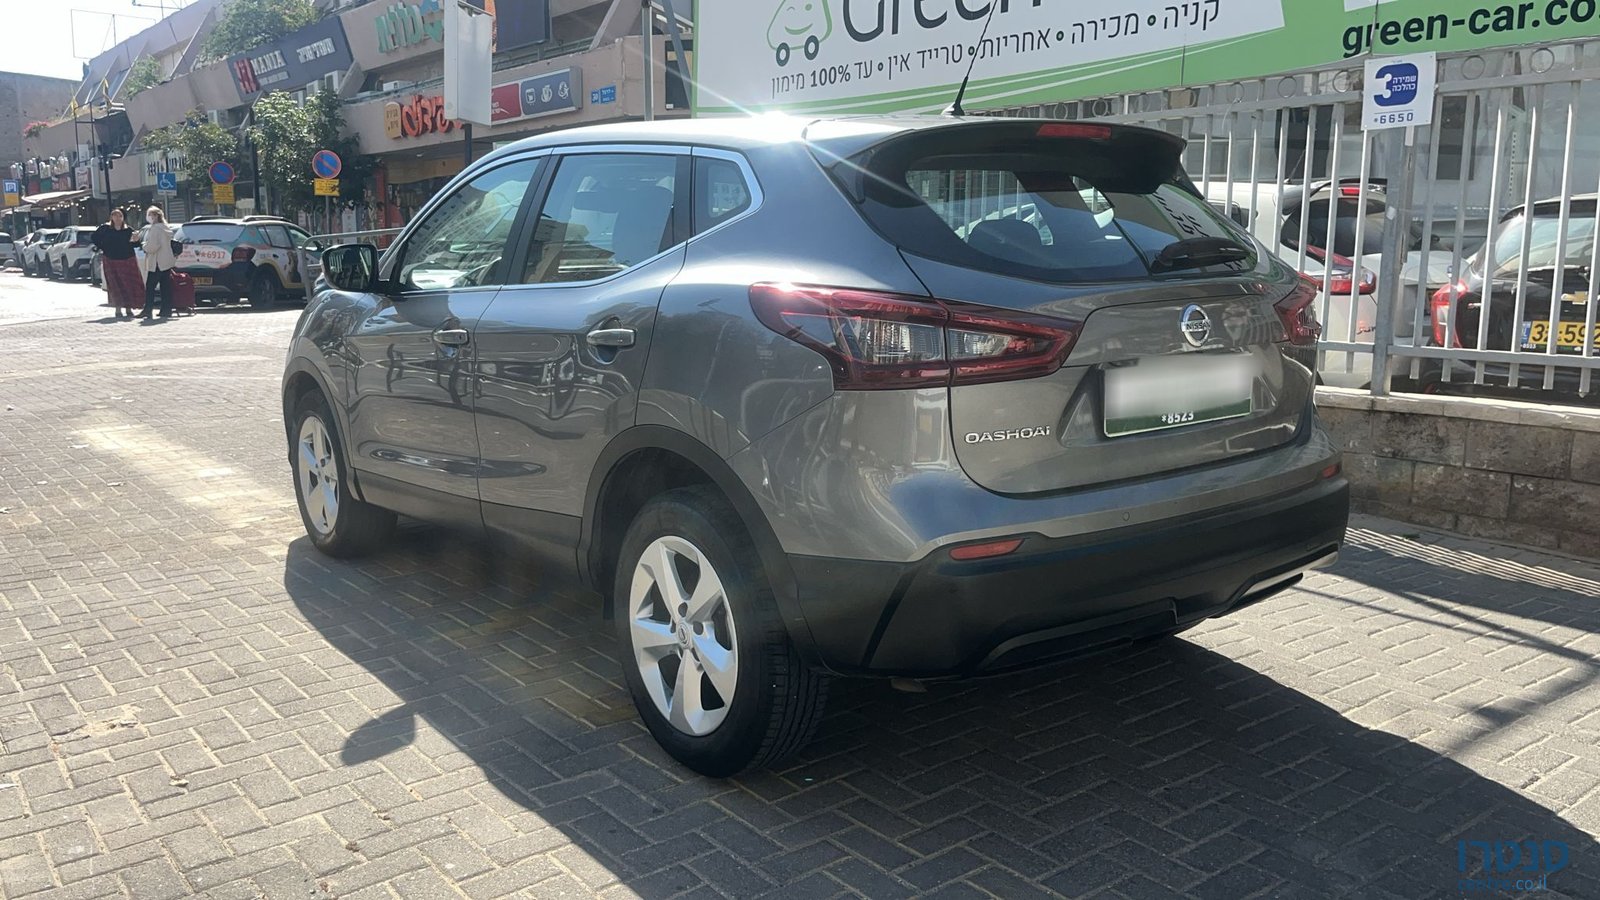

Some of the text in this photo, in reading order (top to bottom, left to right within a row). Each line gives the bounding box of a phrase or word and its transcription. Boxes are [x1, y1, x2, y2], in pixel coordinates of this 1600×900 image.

[771, 0, 1220, 99] קניה מכירה אחריות טרייד אין עד 100% מימון
[1392, 75, 1417, 84] שמירה
[1391, 84, 1416, 92] כהלכה
[1186, 321, 1211, 330] NISSAN
